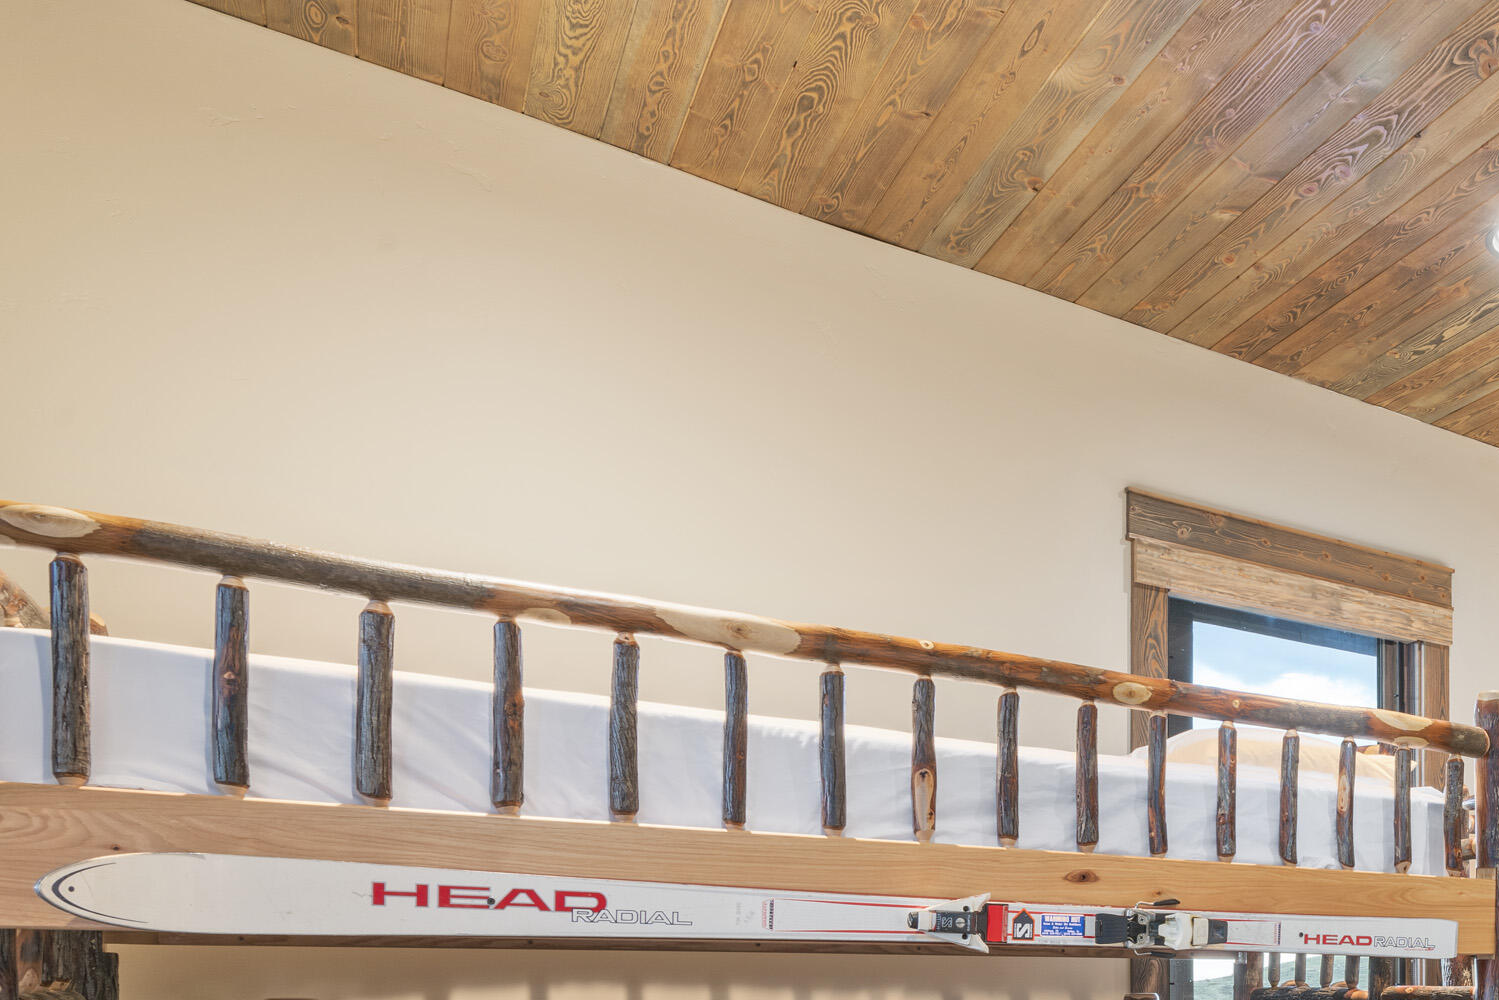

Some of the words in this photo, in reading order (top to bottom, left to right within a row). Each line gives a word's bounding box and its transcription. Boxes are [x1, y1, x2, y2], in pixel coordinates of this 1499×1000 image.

[372, 882, 607, 913] HEAD
[571, 907, 693, 926] RADIAL
[1304, 933, 1372, 946] HEAD
[1374, 935, 1435, 948] RADIAL
